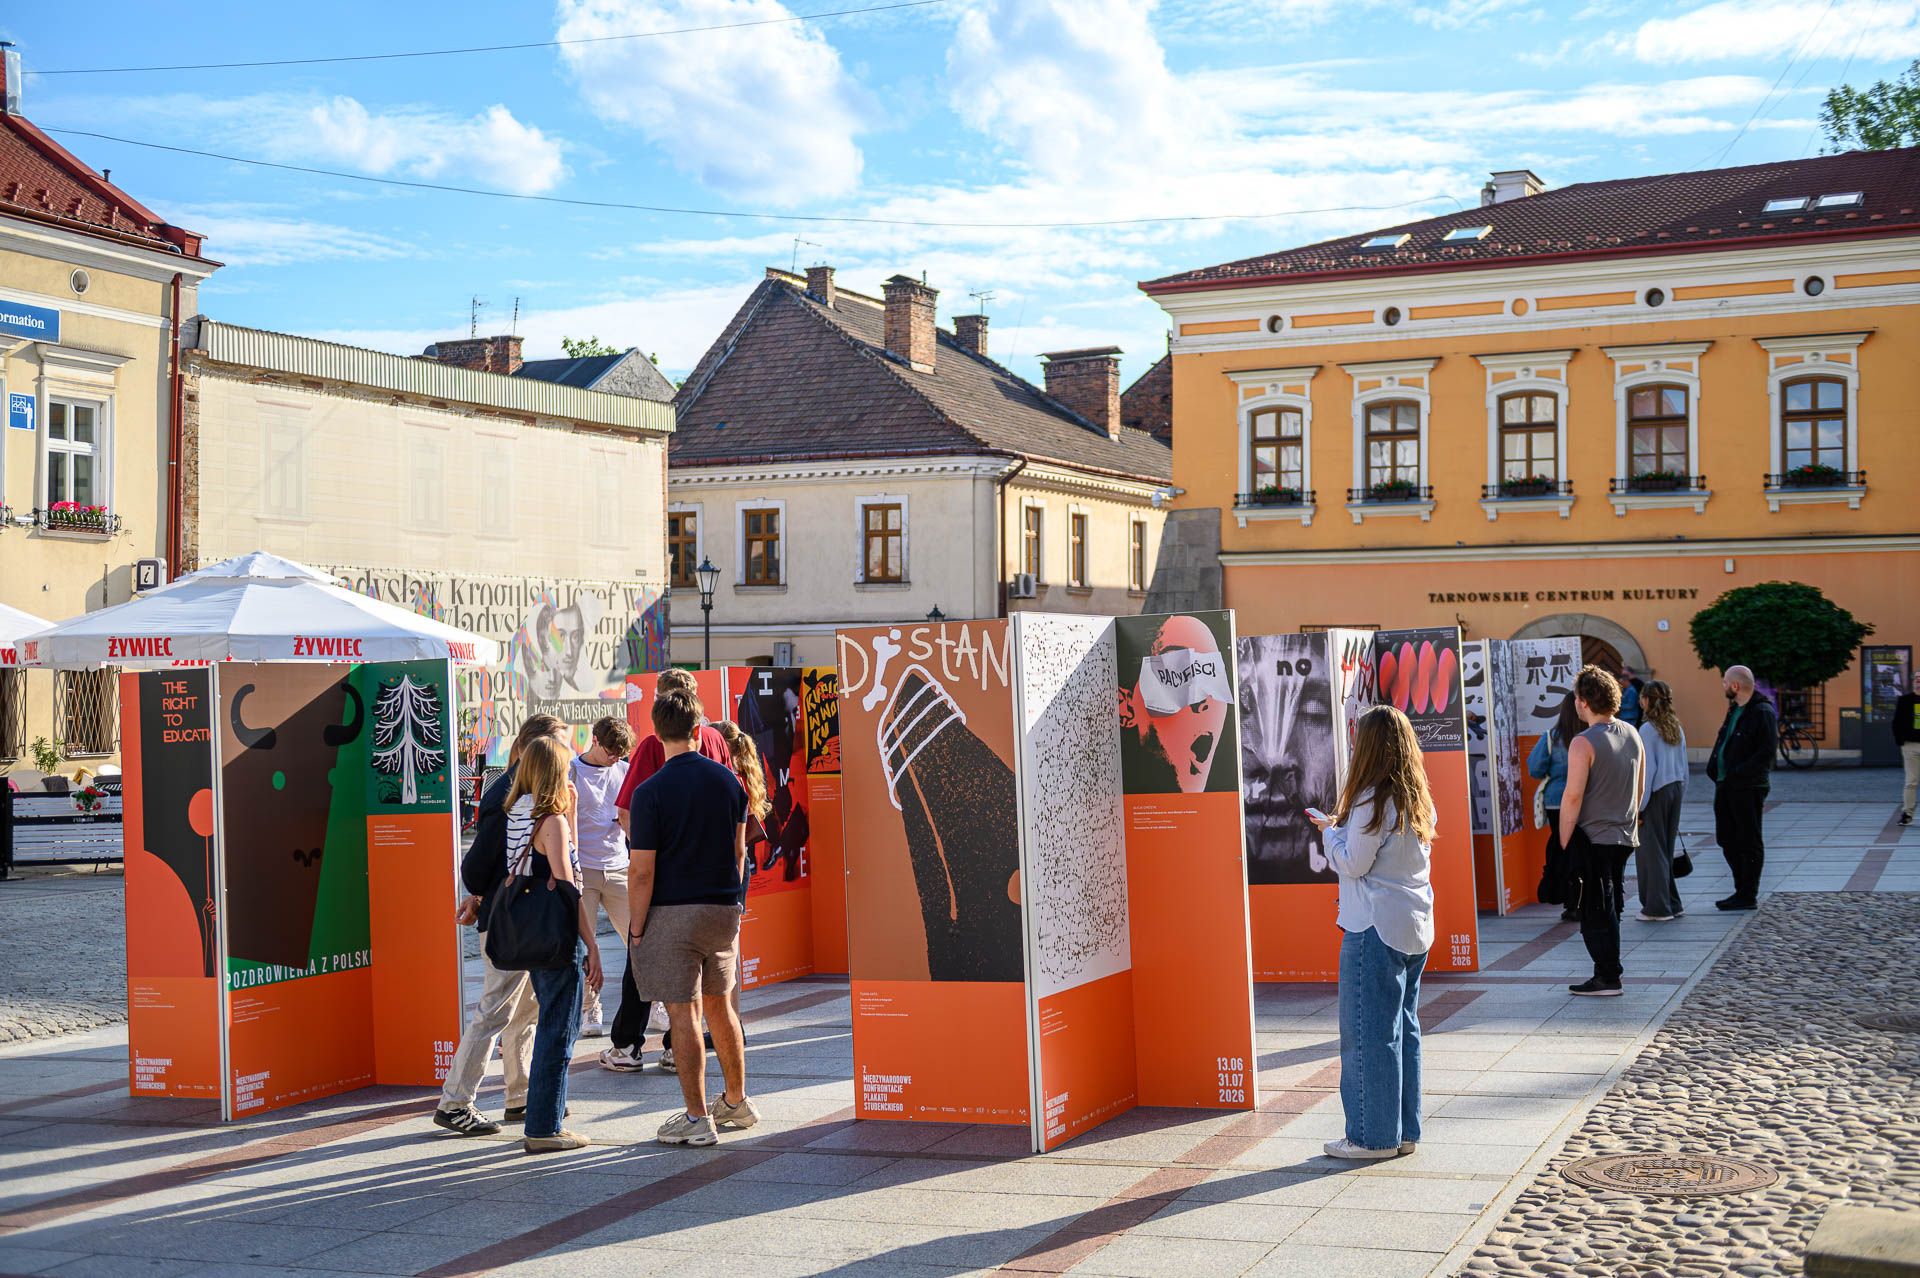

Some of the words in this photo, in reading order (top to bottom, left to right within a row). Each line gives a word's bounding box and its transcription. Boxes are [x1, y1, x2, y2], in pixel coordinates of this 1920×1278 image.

[1428, 591, 1529, 603] TARNOWSKIE
[1535, 590, 1614, 602] CENTRUM
[1622, 588, 1699, 600] KULTURY
[108, 636, 173, 658] ŻYWIEC
[293, 635, 363, 657] ŻYWIEC
[446, 639, 477, 661] ŻYWIEC
[1276, 658, 1312, 677] no
[161, 681, 188, 695] THE
[162, 696, 198, 711] RIGHT
[162, 713, 183, 727] TO
[1450, 934, 1470, 945] 13.06
[1451, 945, 1471, 956] 31.07
[321, 956, 328, 973] Z
[1452, 956, 1472, 967] 2026
[434, 1040, 454, 1053] 13.06
[862, 1064, 867, 1074] 2
[1217, 1057, 1244, 1071] 13.06
[434, 1067, 449, 1080] 202
[1217, 1073, 1244, 1087] 31.07
[863, 1084, 904, 1094] KONFRONTACJE
[1219, 1088, 1245, 1103] 2026
[863, 1093, 888, 1102] PLAKATU
[863, 1102, 904, 1112] STUDENCKIEGO
